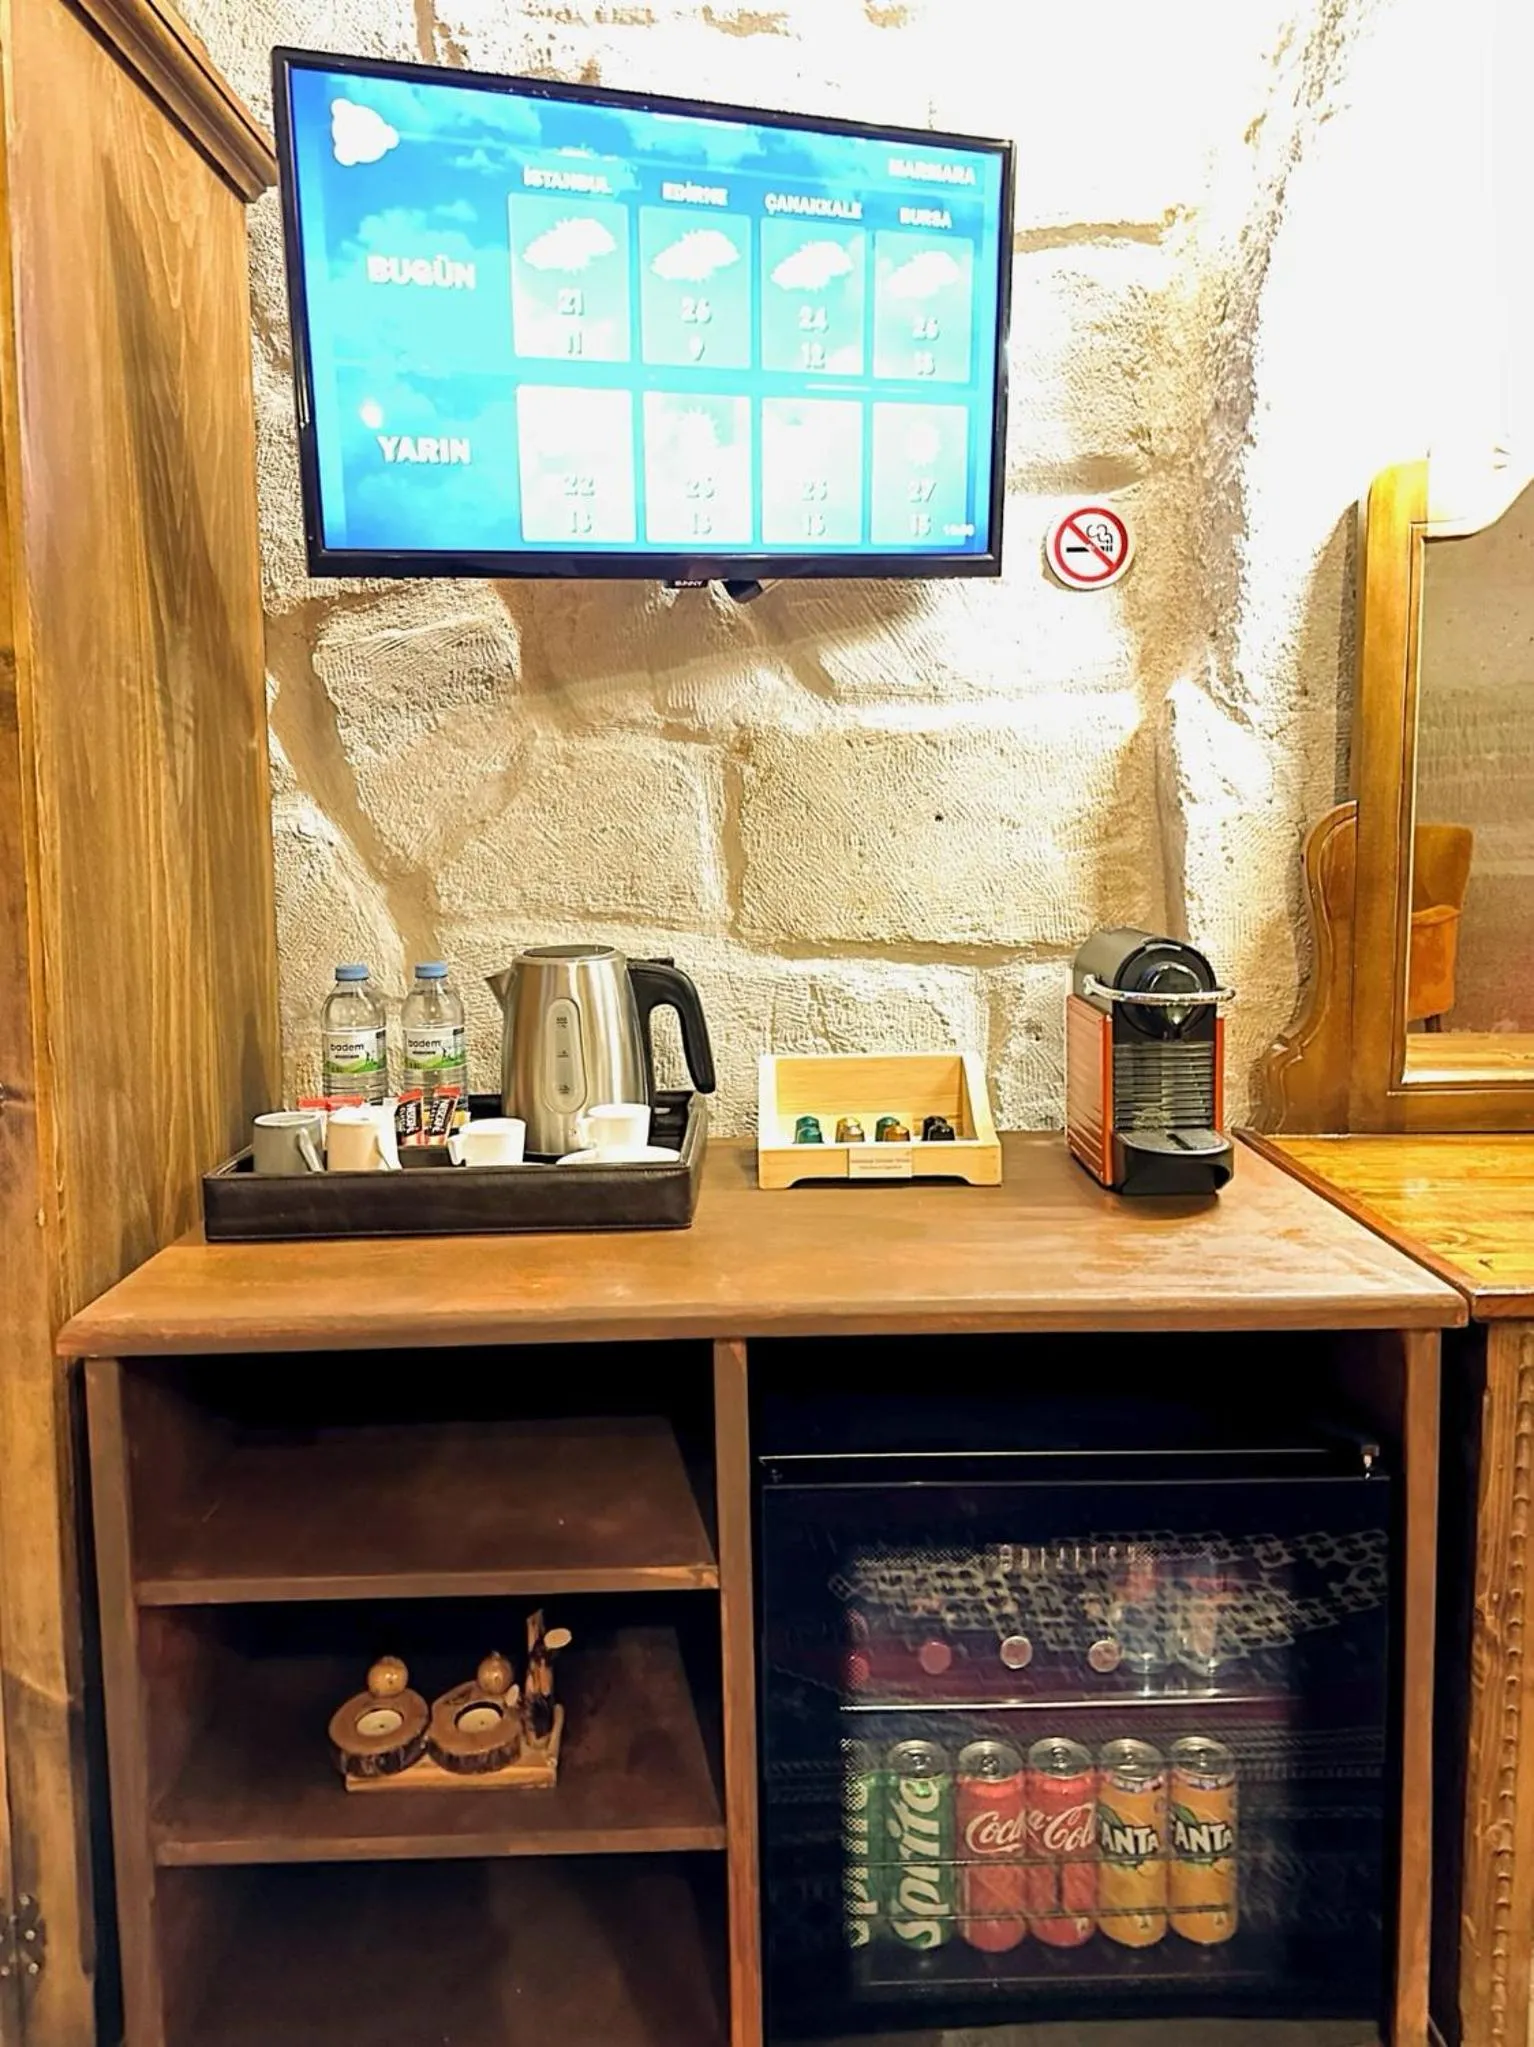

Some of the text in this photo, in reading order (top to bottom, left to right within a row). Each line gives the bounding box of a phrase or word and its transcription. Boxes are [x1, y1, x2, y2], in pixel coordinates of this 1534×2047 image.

[367, 253, 476, 290] BUGÜN
[376, 435, 472, 465] YARIN
[1099, 1819, 1160, 1855] ANTA
[1172, 1815, 1234, 1854] ANTA
